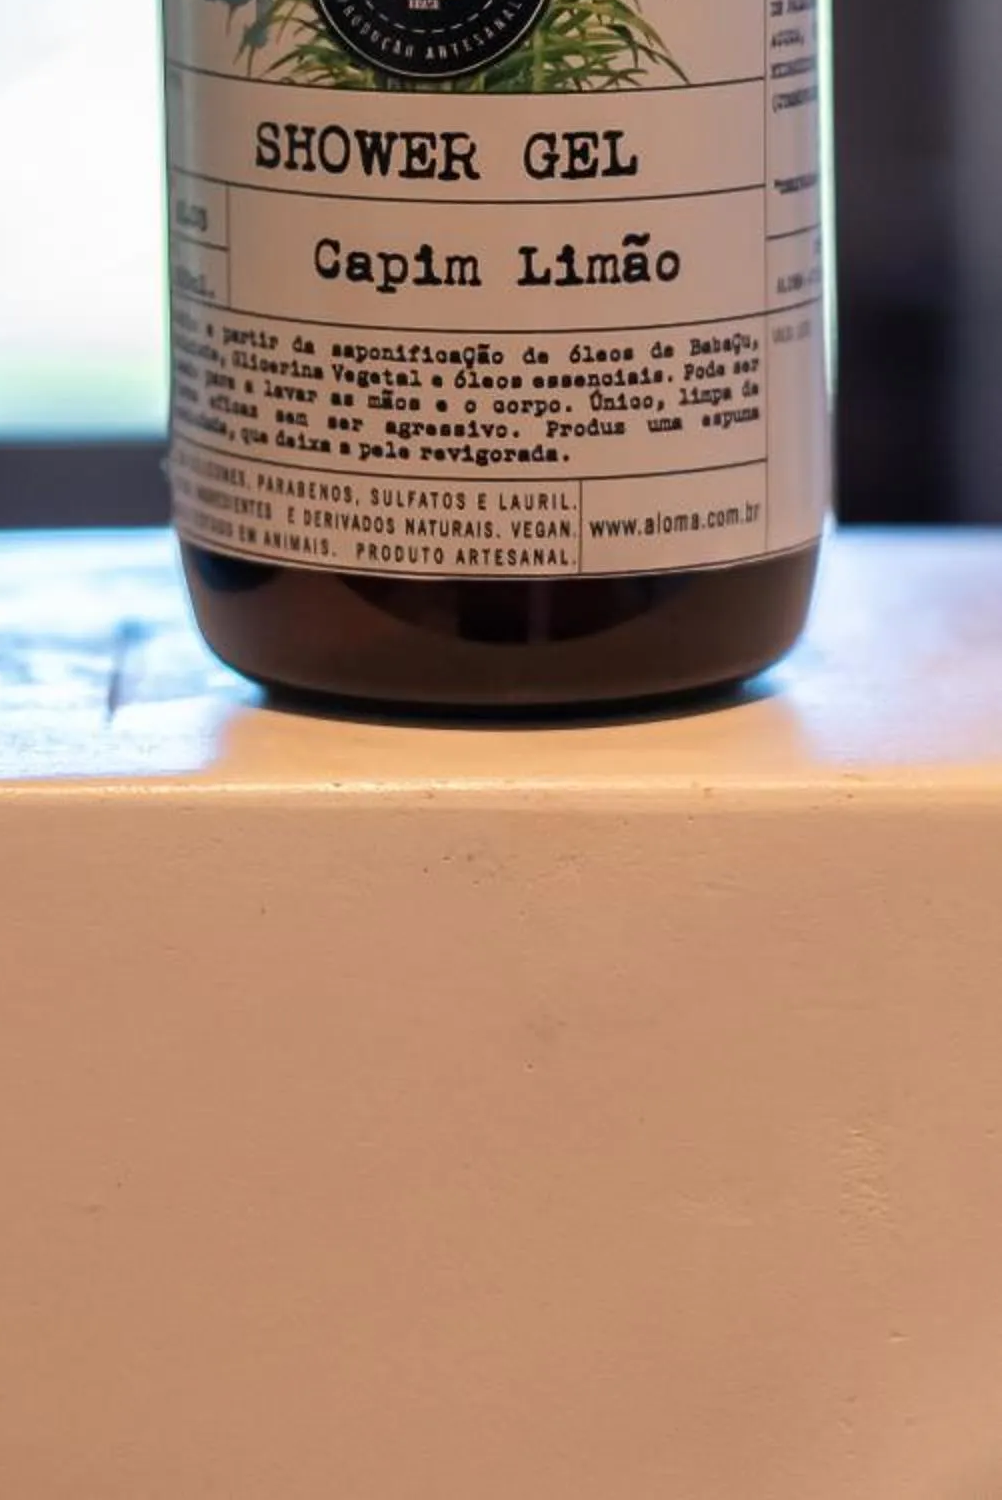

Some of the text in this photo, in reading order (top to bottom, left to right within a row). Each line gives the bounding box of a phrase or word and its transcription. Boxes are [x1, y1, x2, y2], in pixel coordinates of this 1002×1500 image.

[255, 121, 638, 181] SHOWER GEL
[314, 233, 681, 294] Capim Limão
[522, 347, 549, 365] de
[569, 344, 634, 363] óleos
[651, 342, 674, 359] de
[332, 363, 422, 390] Vegetal
[454, 370, 523, 390] óleos
[532, 368, 674, 390] essenciais.
[684, 361, 726, 382] Pode
[733, 358, 760, 376] ser
[263, 378, 318, 404] lavar
[368, 390, 420, 412] mãos
[464, 399, 476, 414] o
[493, 397, 573, 417] corpo.
[679, 384, 732, 407] limpa
[327, 414, 363, 432] ser
[386, 420, 520, 440] agressivo.
[647, 416, 683, 433] uma
[702, 405, 760, 429] espuma
[359, 442, 410, 461] pele
[419, 445, 570, 467] revigorada.
[370, 488, 467, 511] SULFATOS
[478, 492, 487, 511] E
[499, 492, 577, 511] LAURIL.
[287, 506, 295, 524] E
[303, 510, 396, 536] DERIVADOS
[404, 518, 501, 539] NATURAIS.
[589, 502, 760, 538] www.aloma.com.br
[356, 543, 445, 565] PRODUTO
[455, 547, 577, 567] ARTESANAL.
